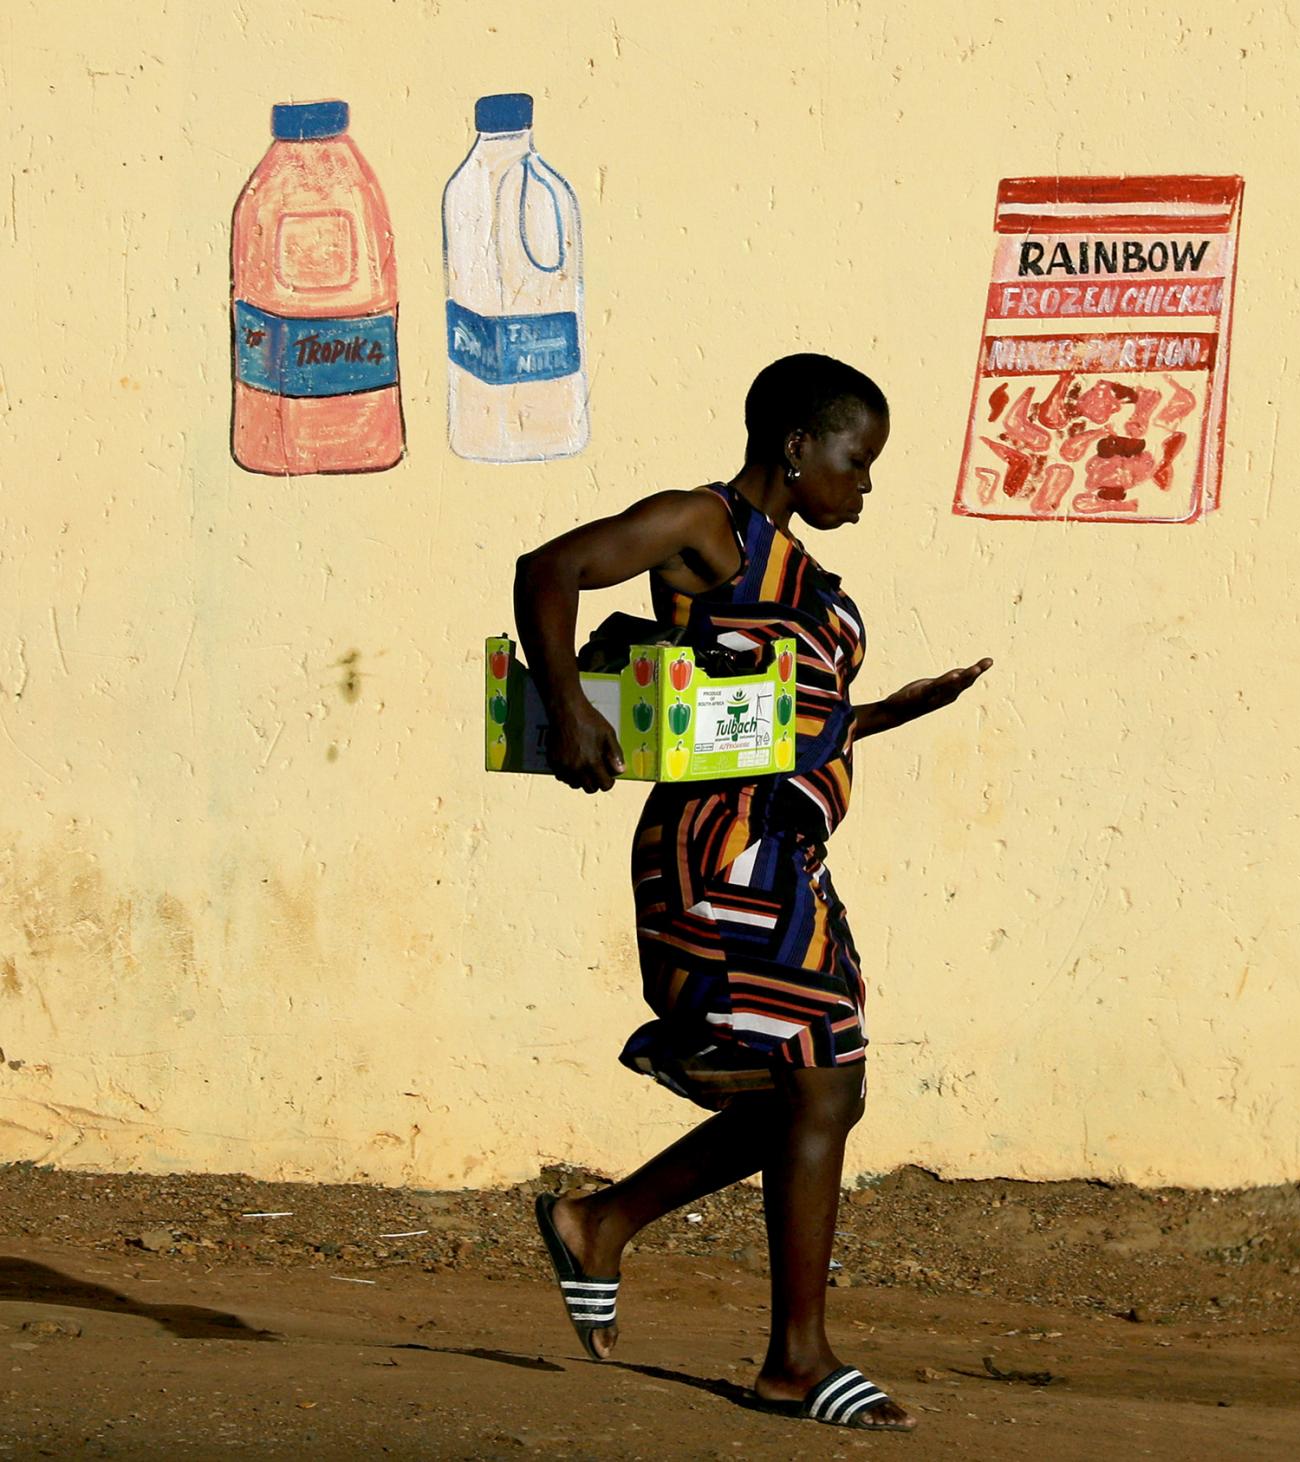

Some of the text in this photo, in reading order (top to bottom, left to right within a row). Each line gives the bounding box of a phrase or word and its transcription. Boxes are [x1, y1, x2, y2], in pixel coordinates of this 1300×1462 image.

[1018, 241, 1210, 276] RAINBOW
[1000, 285, 1225, 316] FROZEN CHICKEN
[293, 333, 385, 367] TROPIKA
[716, 716, 758, 736] Tulbach
